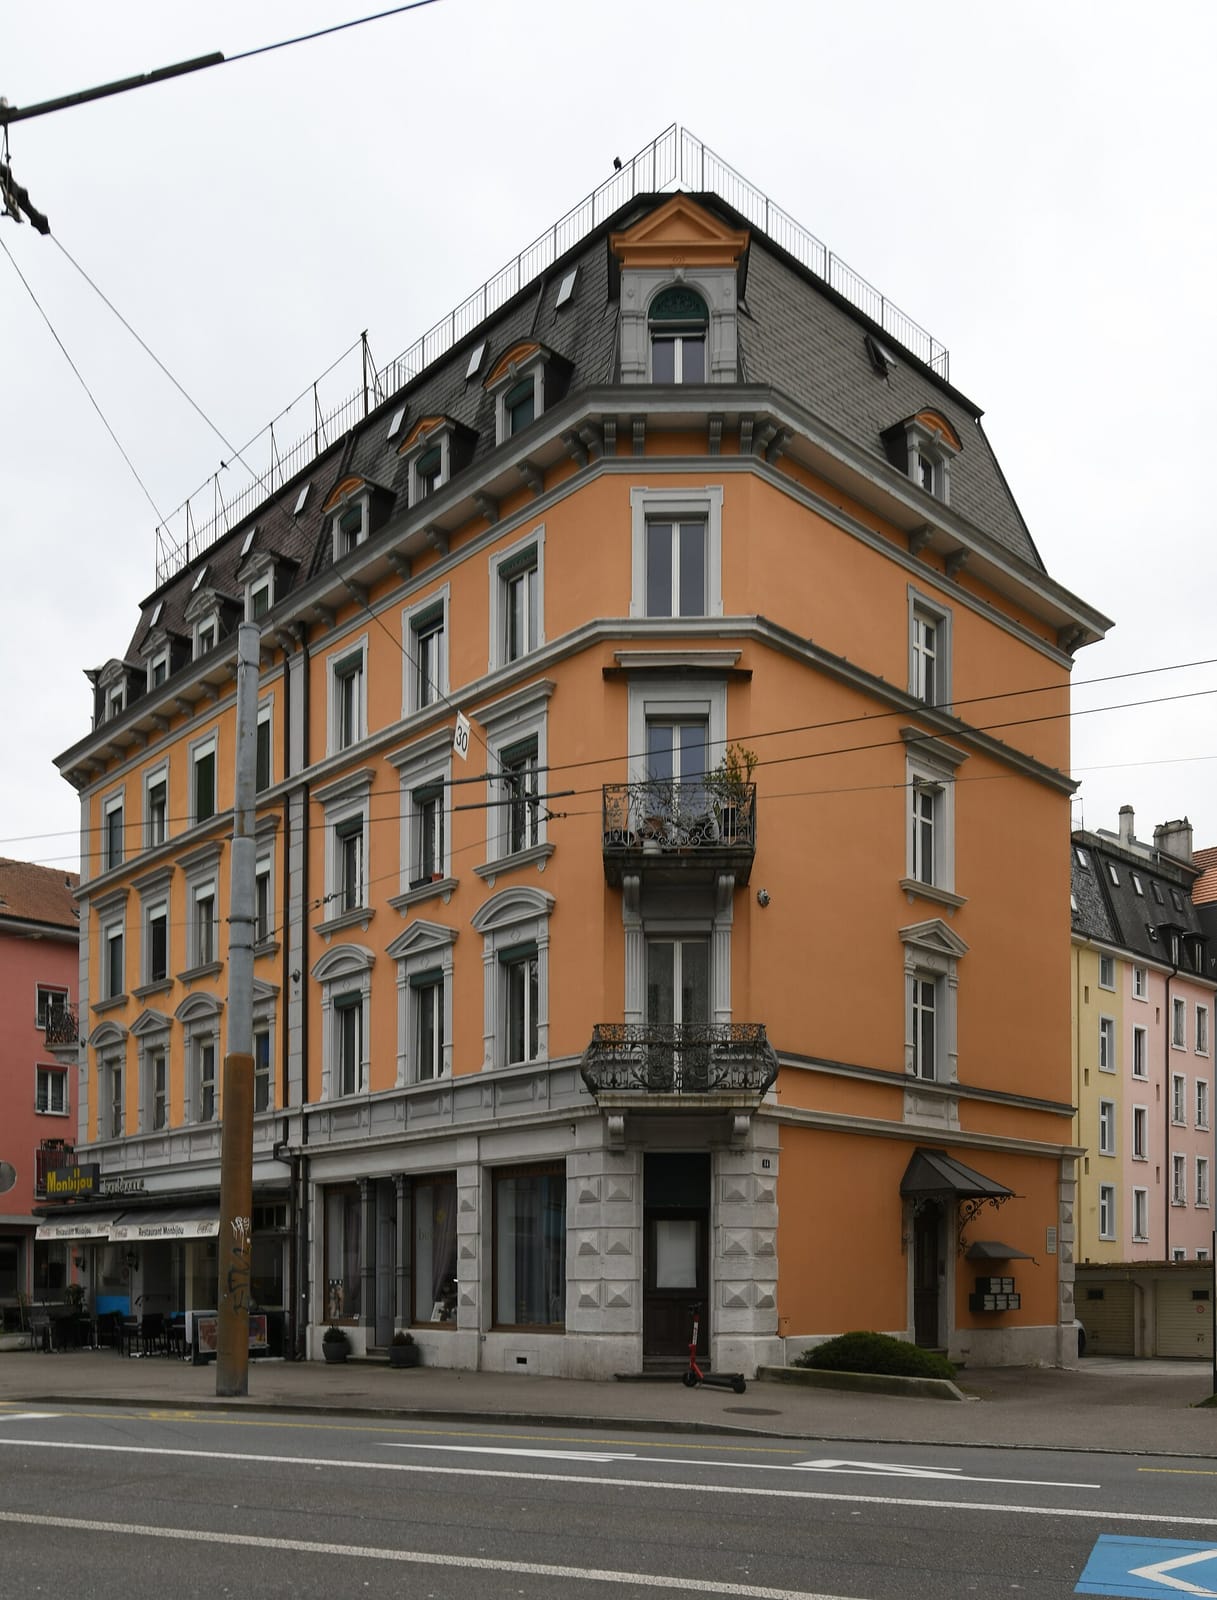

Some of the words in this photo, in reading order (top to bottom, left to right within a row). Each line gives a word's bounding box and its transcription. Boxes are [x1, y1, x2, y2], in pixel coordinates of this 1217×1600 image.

[456, 726, 467, 752] 30
[47, 1168, 93, 1194] Monbijou
[138, 1226, 162, 1237] Restaurant
[163, 1224, 184, 1237] Monbijou
